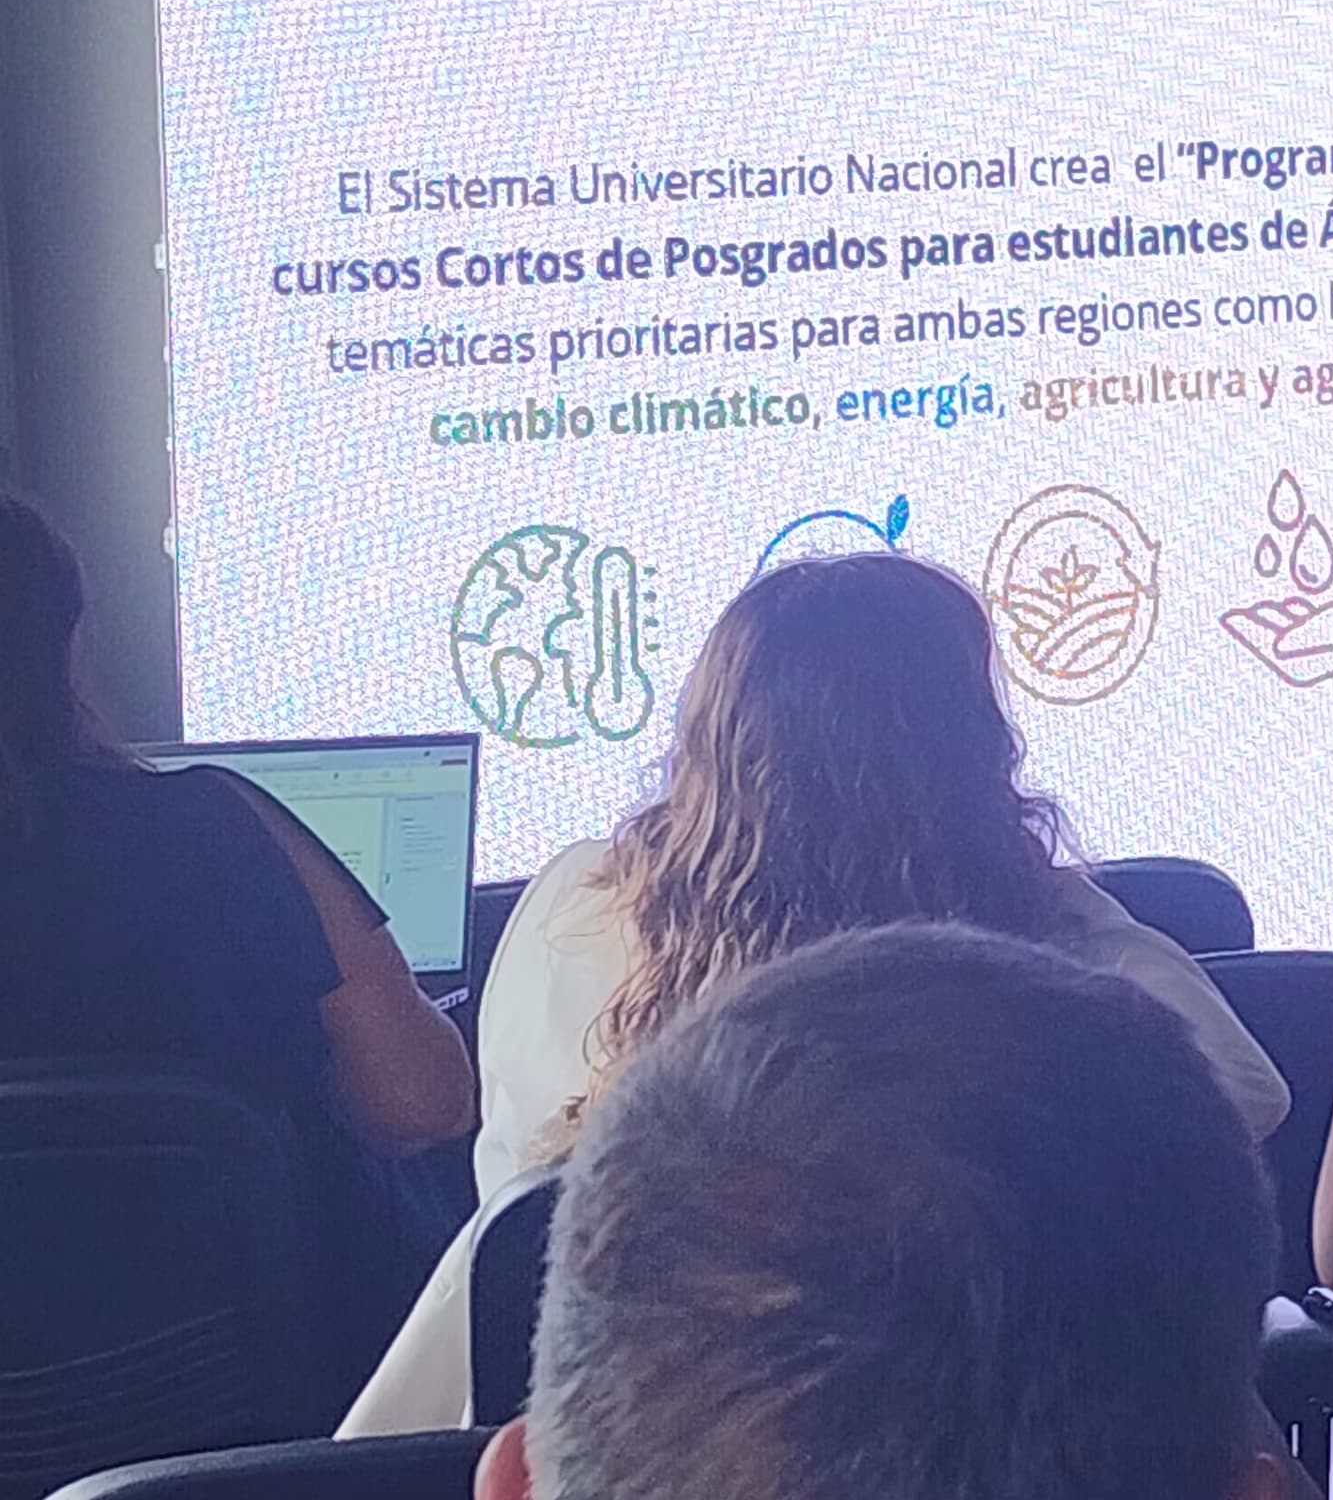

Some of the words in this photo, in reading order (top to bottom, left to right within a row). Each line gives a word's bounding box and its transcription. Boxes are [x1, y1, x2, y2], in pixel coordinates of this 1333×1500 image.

[338, 169, 372, 215] El
[388, 168, 556, 213] Sistema
[570, 156, 833, 205] Universitario
[846, 147, 1016, 194] Nacional
[1030, 153, 1111, 187] crea
[1135, 141, 1166, 183] el
[273, 254, 422, 295] cursos
[435, 245, 585, 289] Cortos
[596, 236, 653, 282] de
[664, 227, 888, 289] Posgrados
[901, 232, 995, 280] para
[1006, 214, 1249, 263] estudiantes
[1260, 208, 1308, 251] de
[327, 323, 536, 373] temáticas
[549, 311, 779, 376] prioritarias
[792, 313, 880, 362] para
[894, 297, 1026, 342] ambas
[1038, 292, 1202, 347] regiones
[1213, 291, 1318, 326] como
[430, 396, 595, 446] cambio
[609, 385, 822, 436] climático,
[836, 373, 1006, 429] energía,
[1018, 363, 1247, 423] agricultura
[1258, 364, 1280, 409] y
